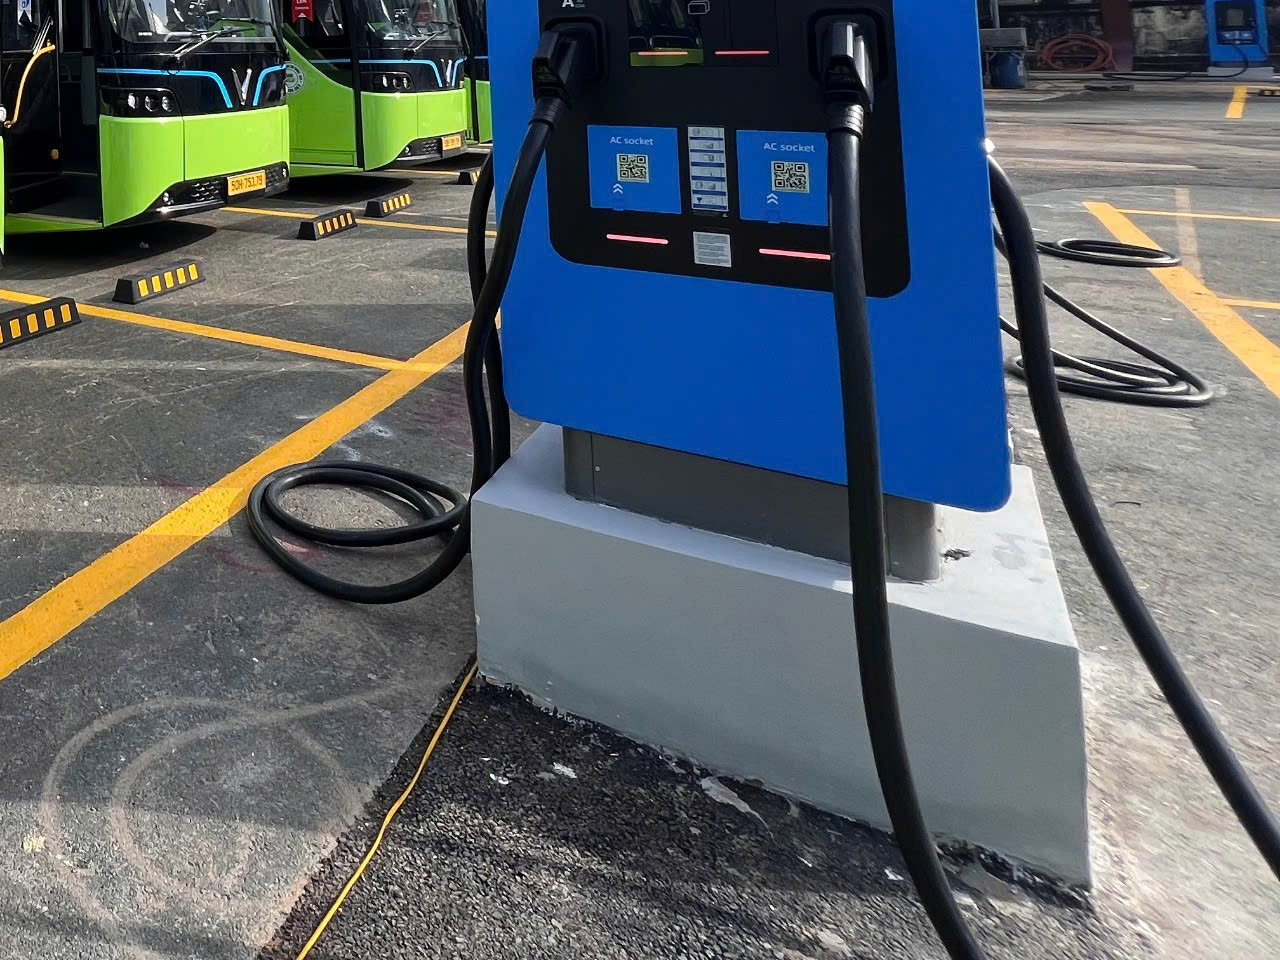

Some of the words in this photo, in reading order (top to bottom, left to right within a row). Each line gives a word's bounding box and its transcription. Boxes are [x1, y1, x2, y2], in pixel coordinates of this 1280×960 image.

[609, 136, 622, 144] AC
[623, 136, 654, 146] socket
[763, 142, 778, 151] AC
[780, 143, 816, 153] socket
